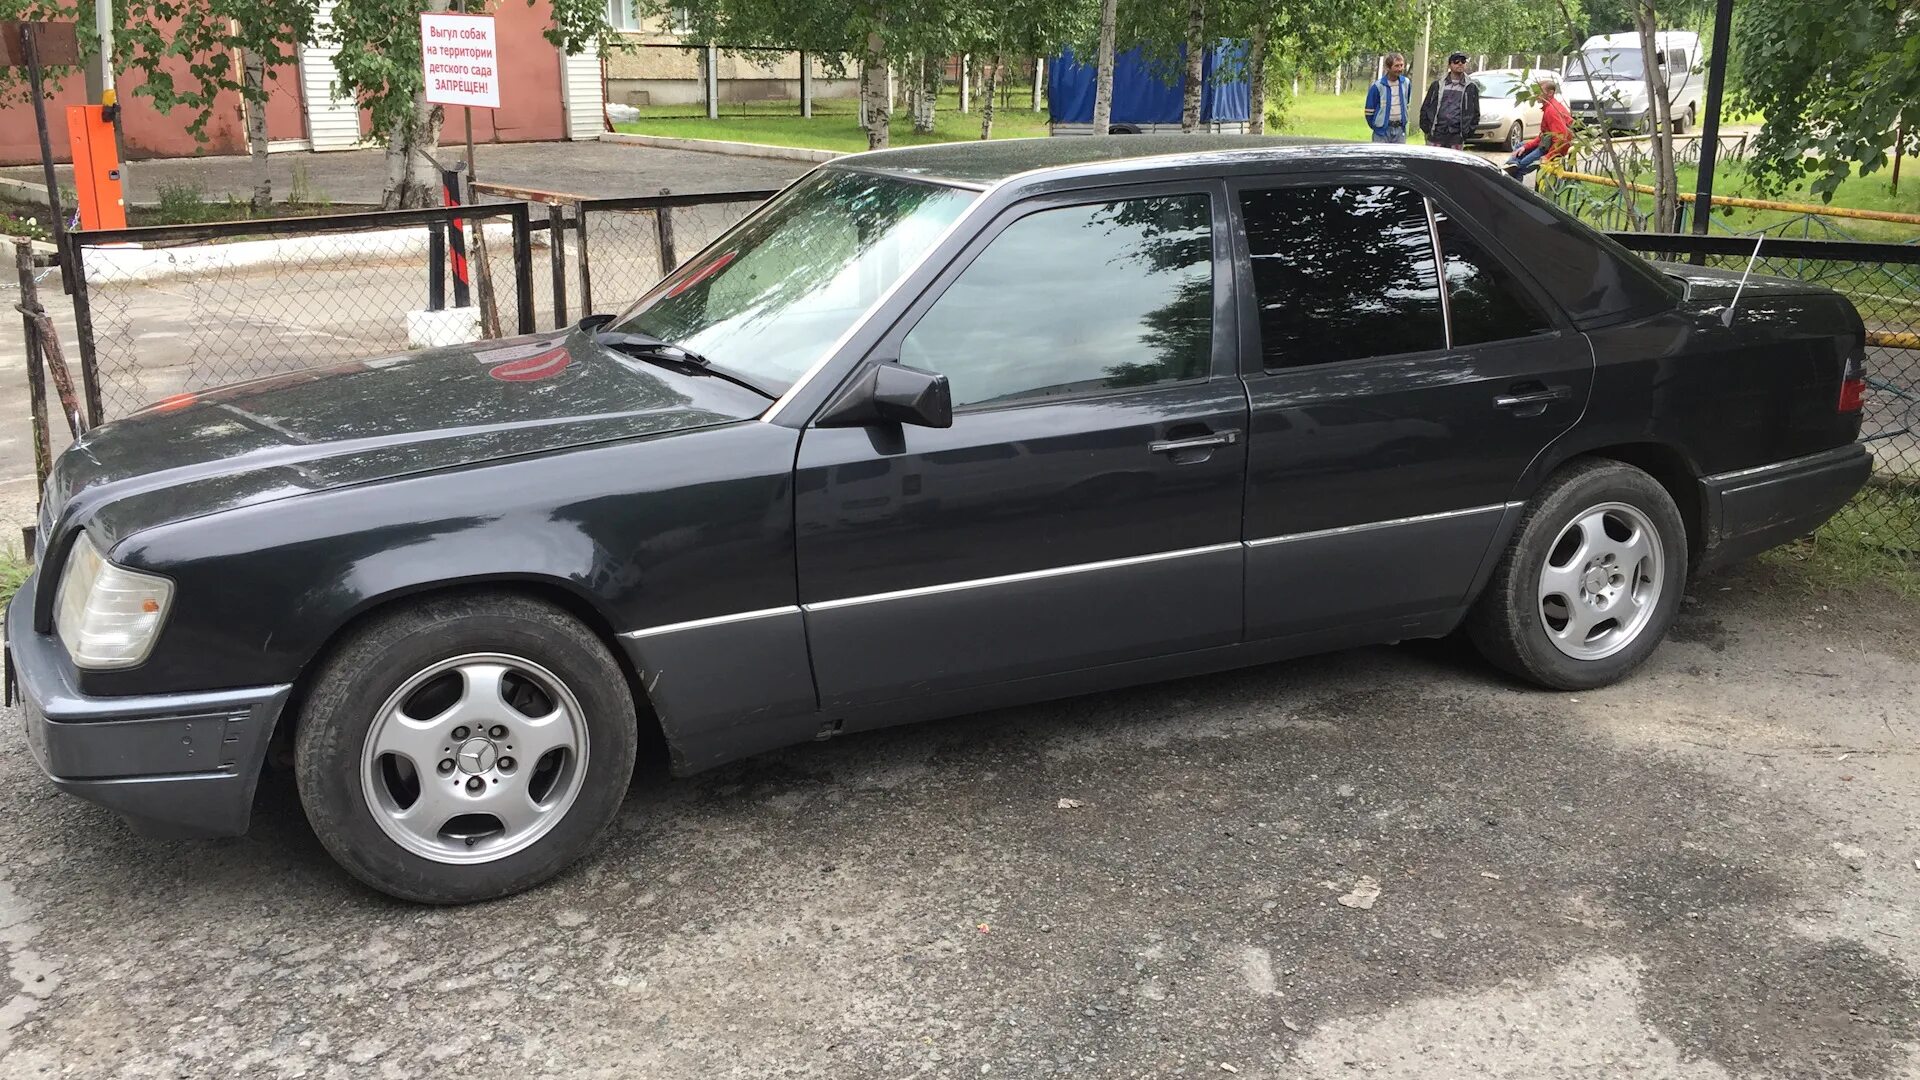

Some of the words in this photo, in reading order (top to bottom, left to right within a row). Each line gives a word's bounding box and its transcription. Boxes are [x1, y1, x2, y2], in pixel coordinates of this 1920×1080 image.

[430, 26, 458, 40] Выгул
[460, 28, 487, 40] собак
[427, 46, 437, 55] на
[440, 46, 493, 59] территории
[430, 63, 469, 75] детского
[471, 66, 492, 77] сада
[435, 79, 489, 94] ЗАПРЕЩЕН!
